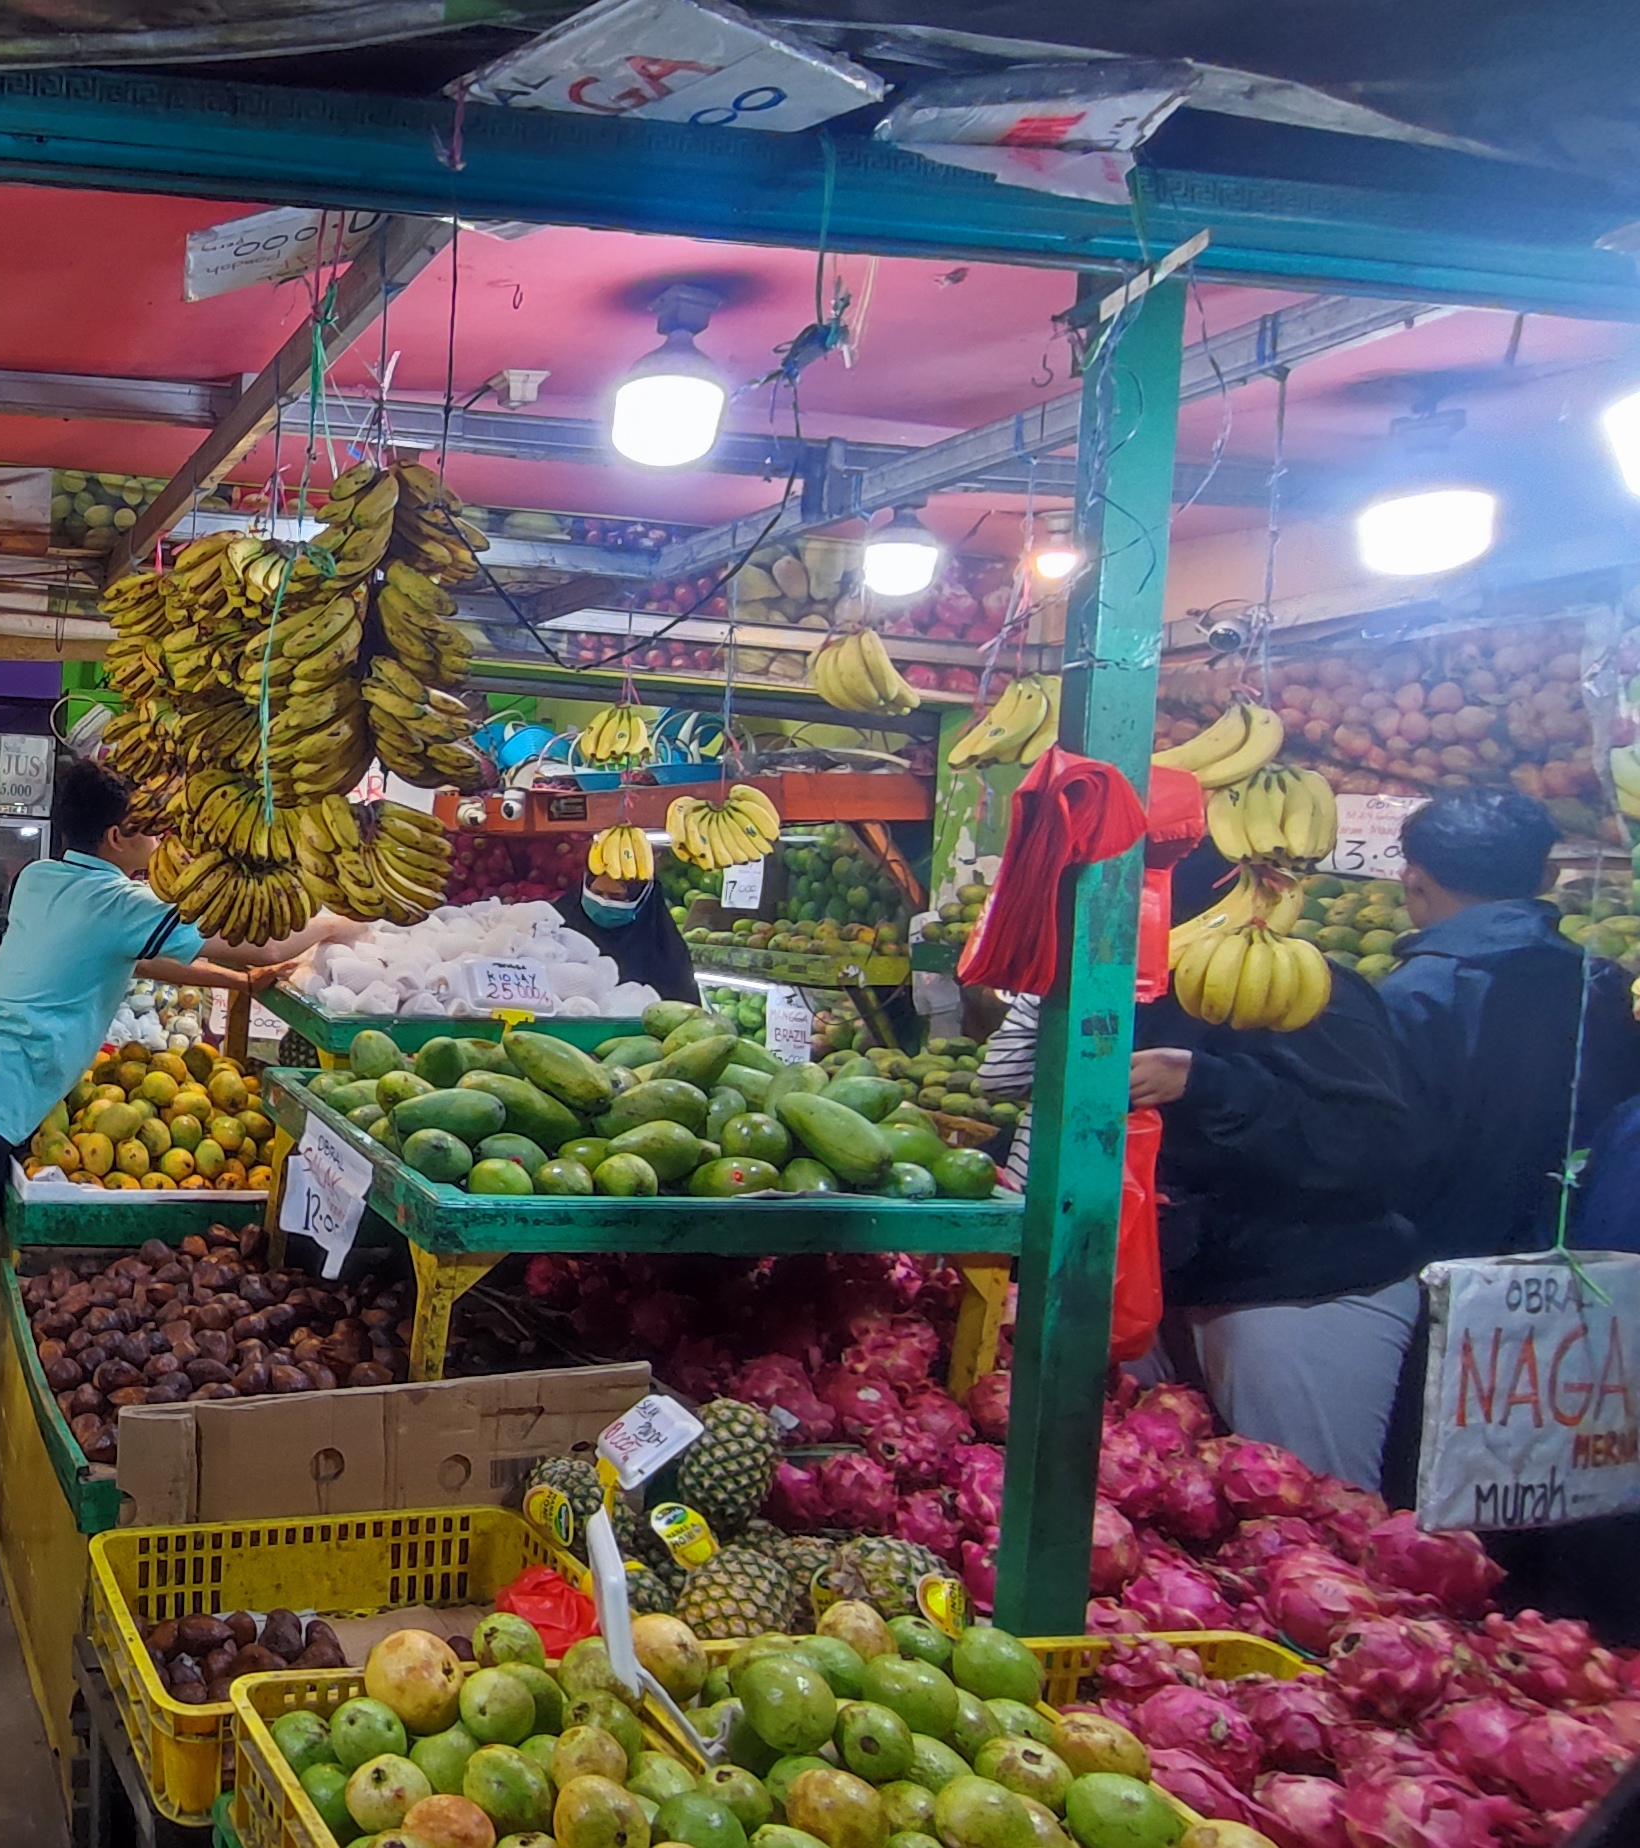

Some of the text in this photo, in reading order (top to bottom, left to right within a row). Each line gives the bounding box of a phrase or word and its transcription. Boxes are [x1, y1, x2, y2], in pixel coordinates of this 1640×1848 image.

[2, 753, 40, 778] JUS
[0, 783, 32, 798] 5.000
[774, 1027, 812, 1045] BRAZIL
[1456, 1315, 1632, 1429] NAGA
